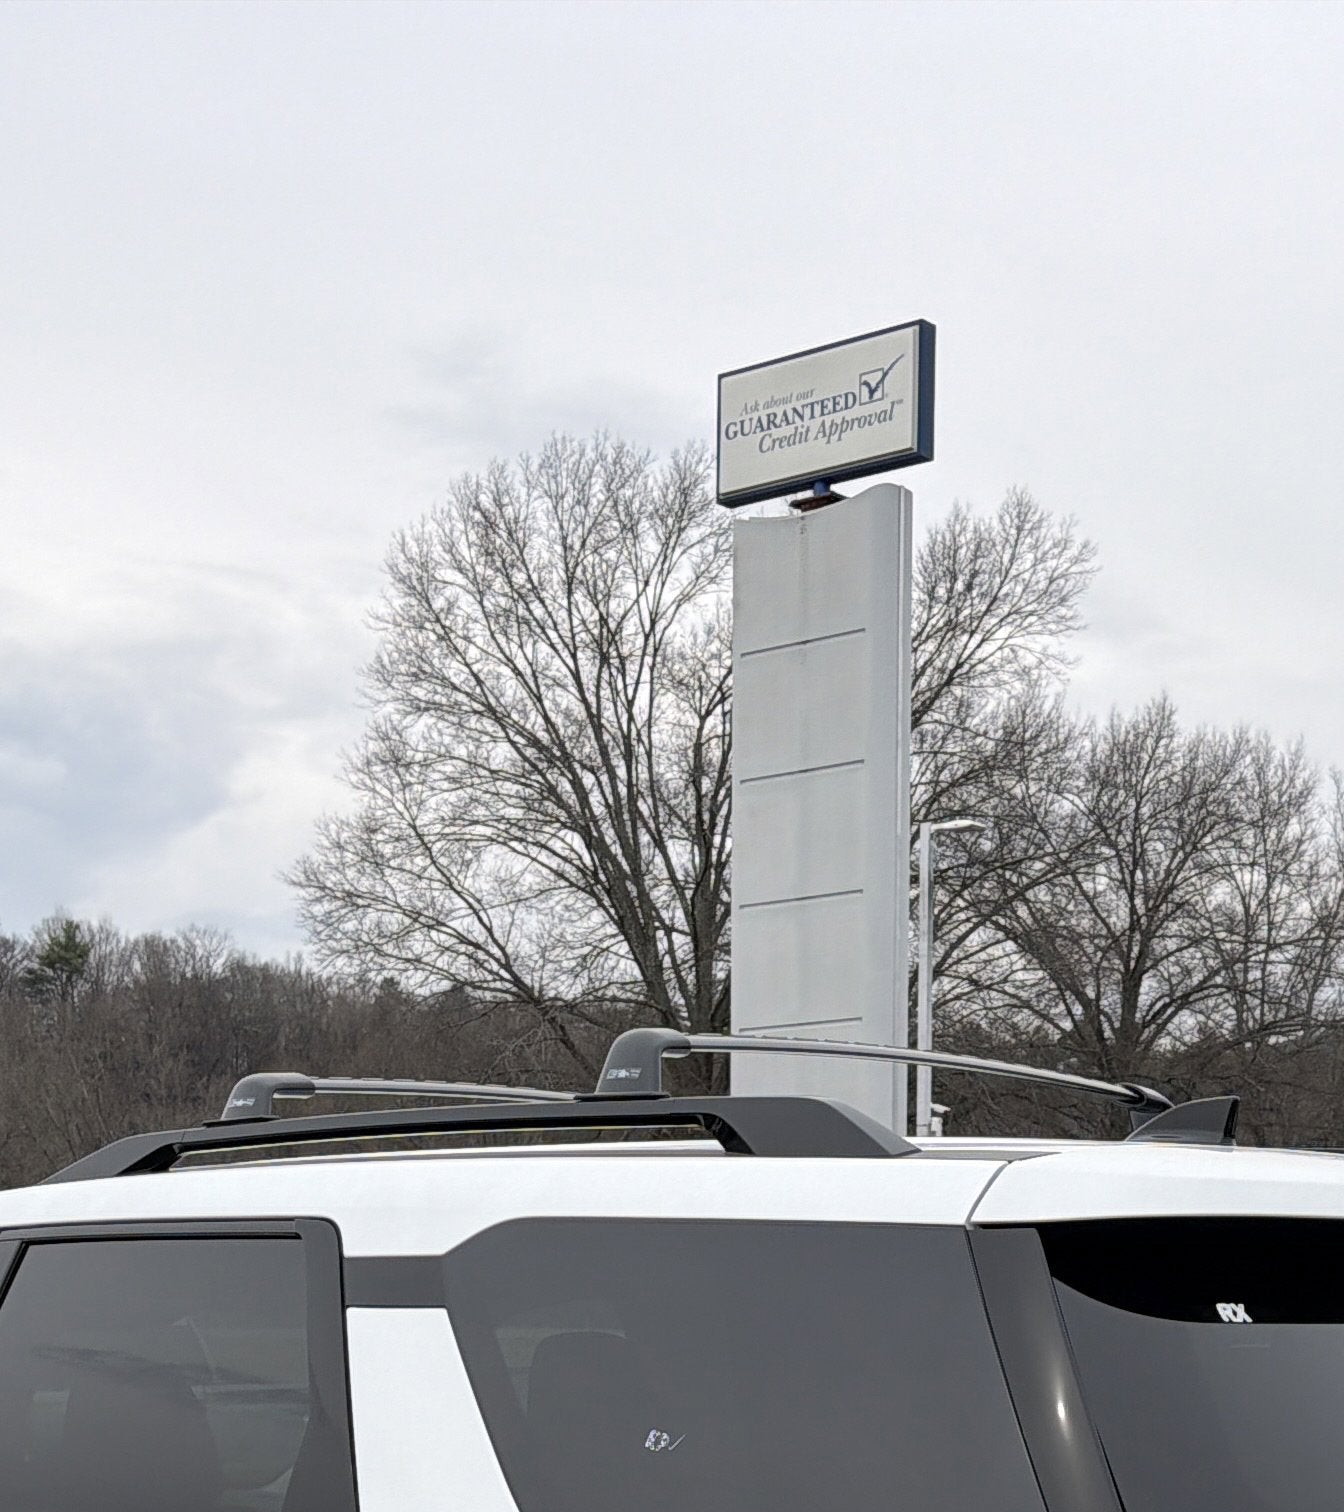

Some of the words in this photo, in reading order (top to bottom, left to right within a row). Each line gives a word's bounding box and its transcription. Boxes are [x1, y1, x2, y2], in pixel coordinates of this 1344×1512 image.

[724, 391, 857, 441] GUARANTEED
[739, 403, 760, 417] Ask
[762, 393, 794, 411] about
[795, 388, 816, 402] our
[758, 424, 811, 454] Credit
